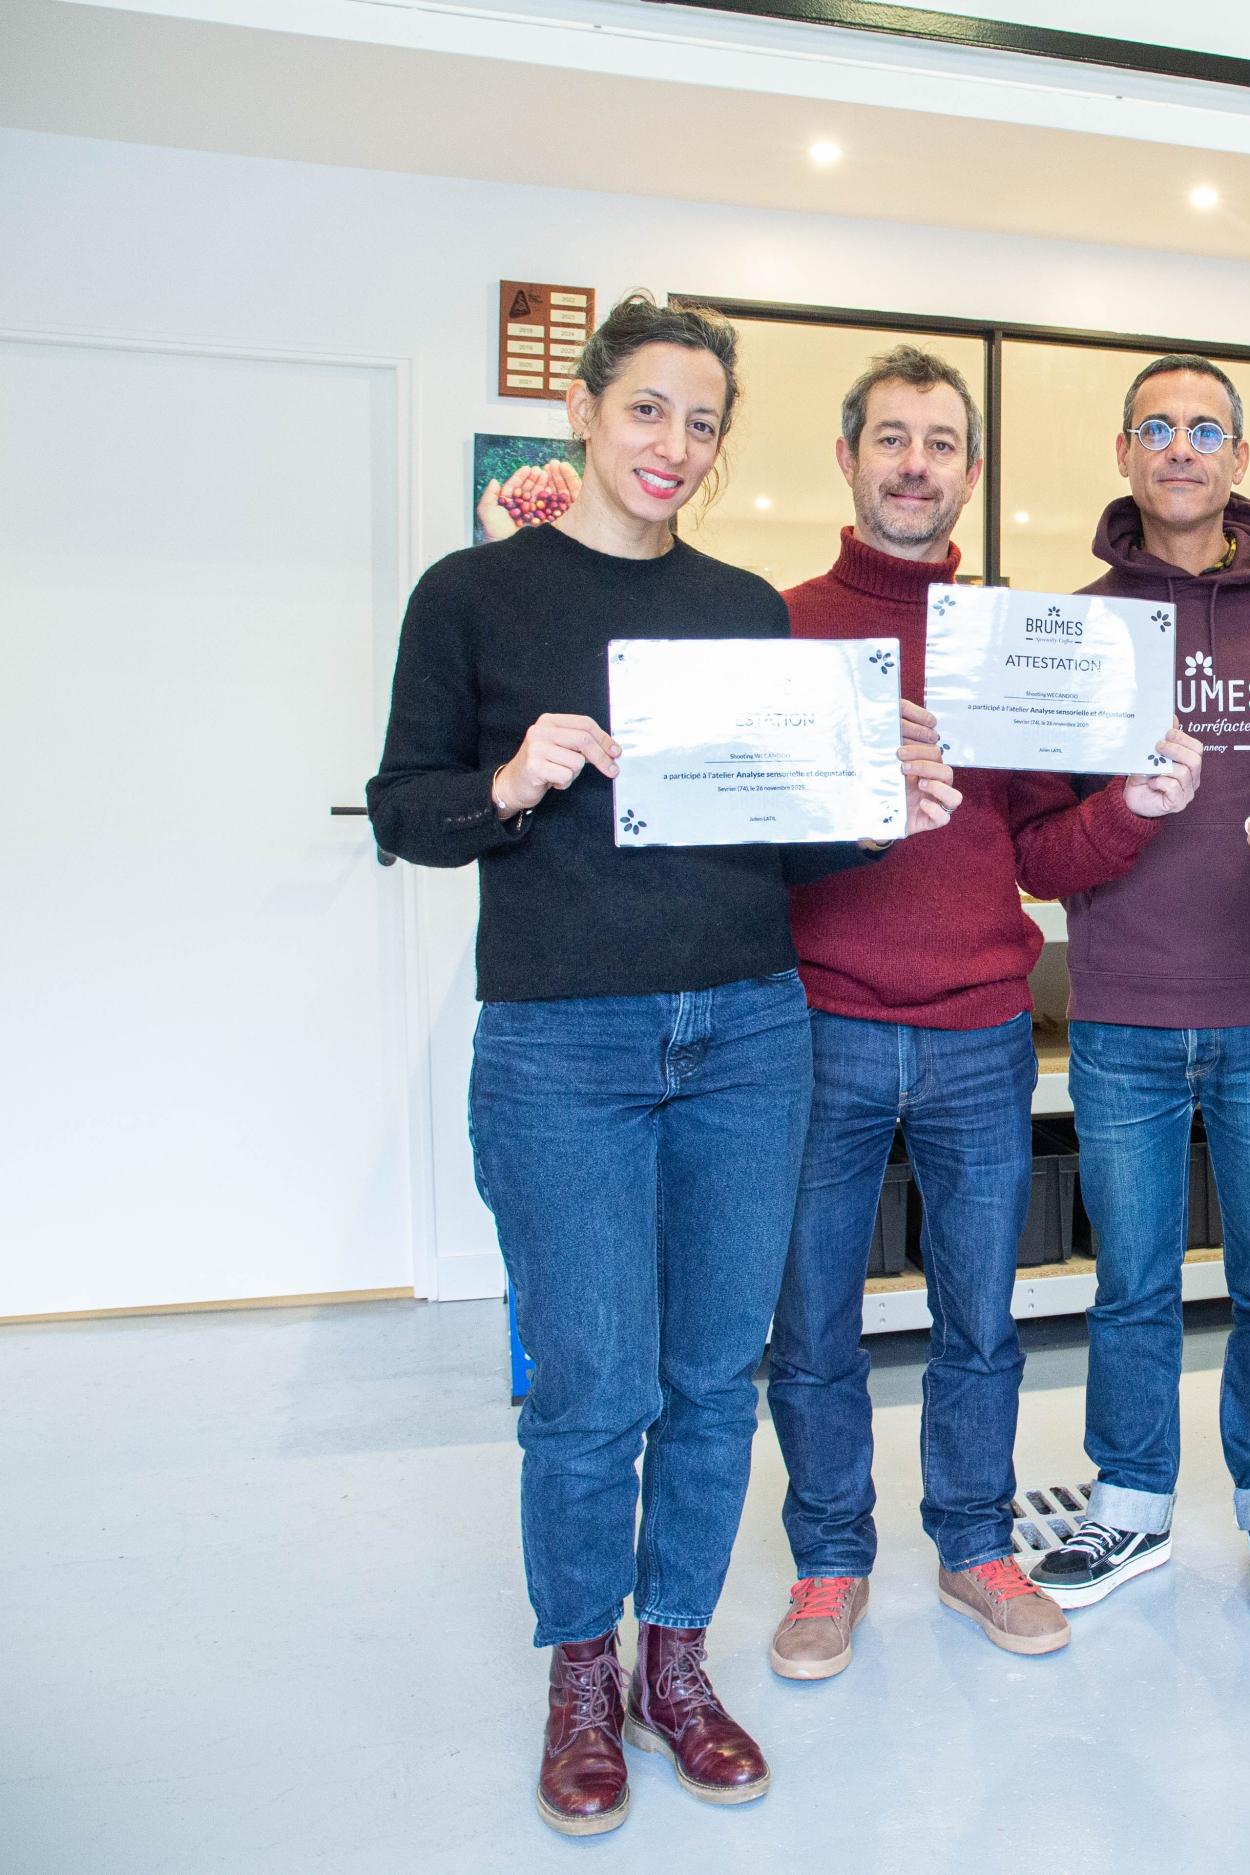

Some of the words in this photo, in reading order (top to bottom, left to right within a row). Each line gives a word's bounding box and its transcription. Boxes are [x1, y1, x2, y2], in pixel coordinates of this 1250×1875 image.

[1025, 617, 1083, 636] BRUMES
[1005, 654, 1101, 672] ATTESTATION
[972, 704, 1001, 712] participé
[1006, 705, 1029, 713] l'atelier
[1030, 707, 1055, 715] Analyse
[1055, 708, 1090, 717] sensorielle
[1203, 744, 1228, 754] nnecy
[669, 772, 701, 781] participé
[708, 771, 735, 779] l'atelier
[736, 770, 765, 780] Analyse
